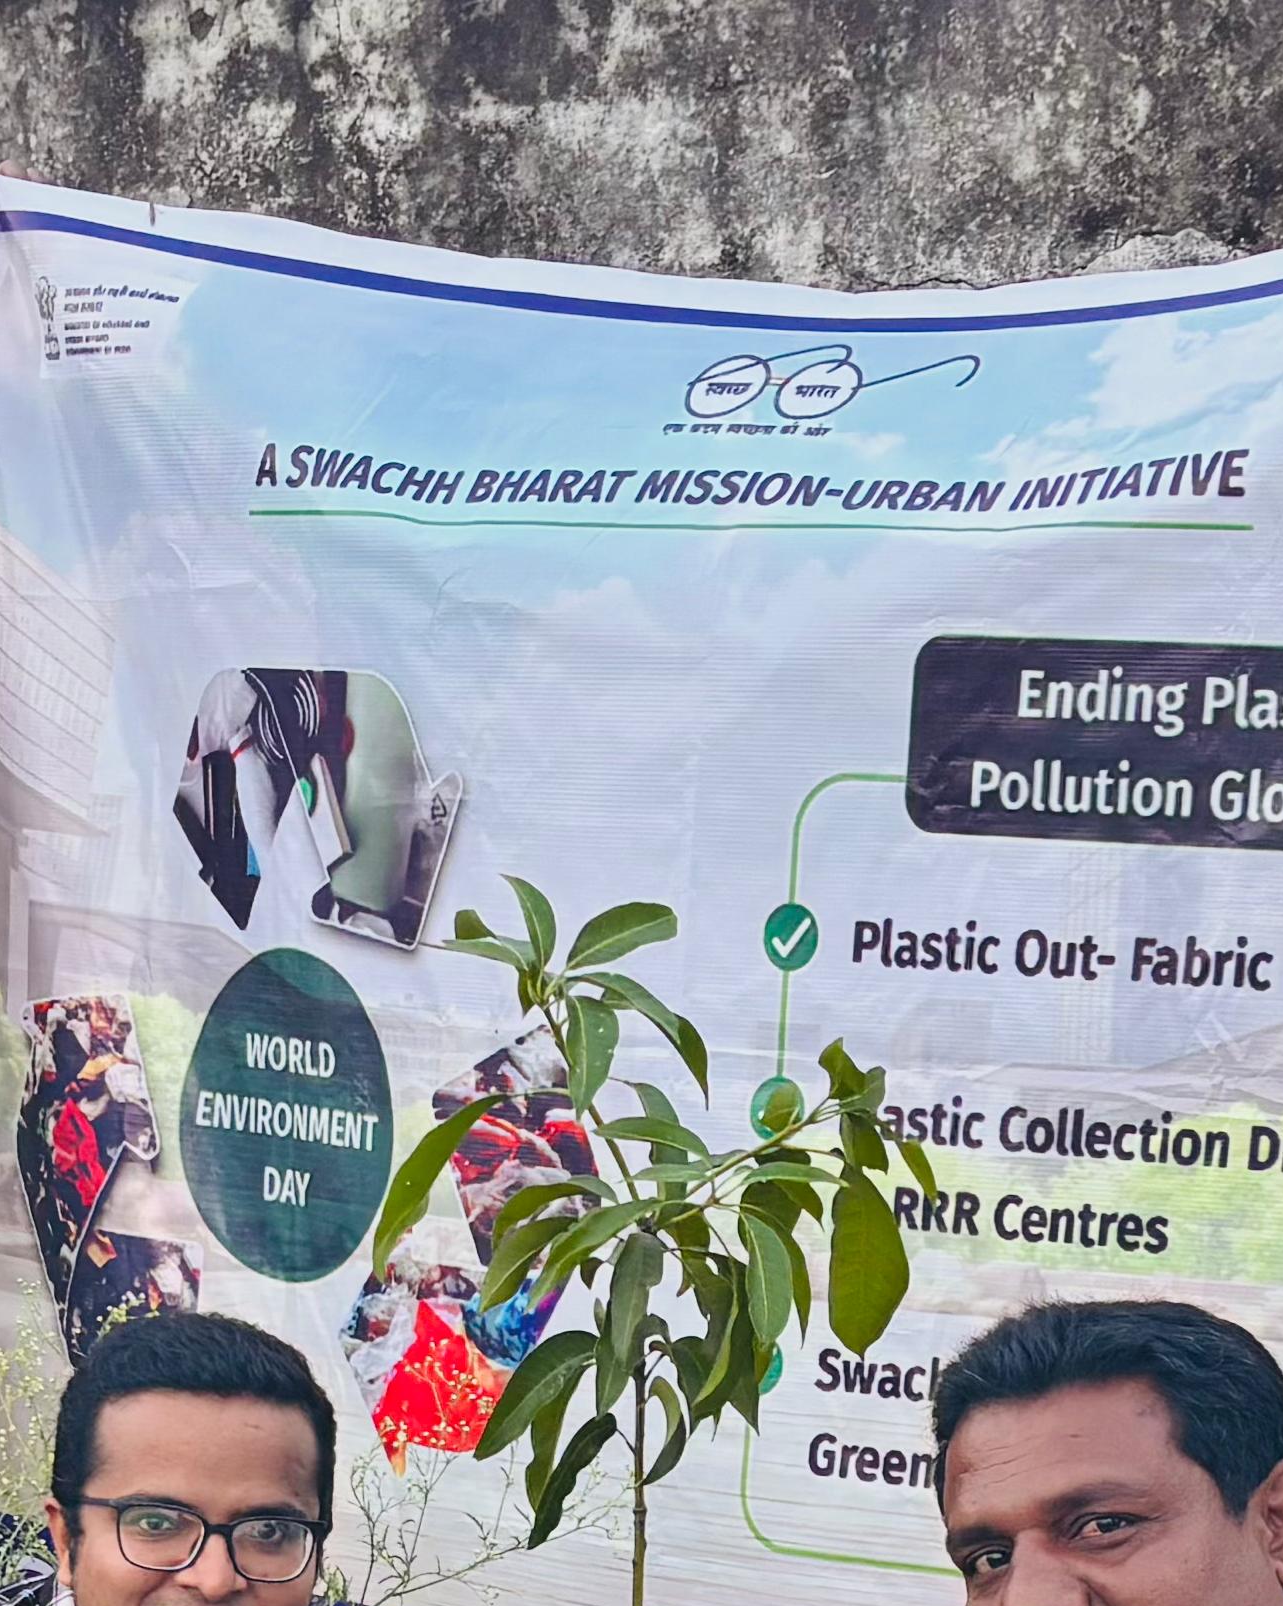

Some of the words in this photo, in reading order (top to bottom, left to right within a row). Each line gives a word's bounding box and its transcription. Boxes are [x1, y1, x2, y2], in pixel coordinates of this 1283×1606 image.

[794, 385, 841, 399] भारत
[255, 443, 277, 488] A
[285, 445, 465, 504] SWACHH
[465, 470, 637, 504] BHARAT
[634, 469, 1006, 512] MISSION-URBAN
[1008, 448, 1250, 512] INITIATIVE
[1017, 666, 1188, 738] Ending
[970, 759, 1193, 818] Pollution
[851, 917, 1000, 975] Plastic
[1014, 929, 1116, 980] Out-
[1131, 935, 1272, 992] Fabric
[244, 1032, 336, 1079] WORLD
[195, 1090, 379, 1151] ENVIRONMENT
[880, 1095, 986, 1149] astic
[998, 1105, 1230, 1168] Collection
[263, 1165, 312, 1207] DAY
[893, 1186, 981, 1236] RRR
[993, 1193, 1170, 1255] Centres
[808, 1432, 933, 1489] Green
